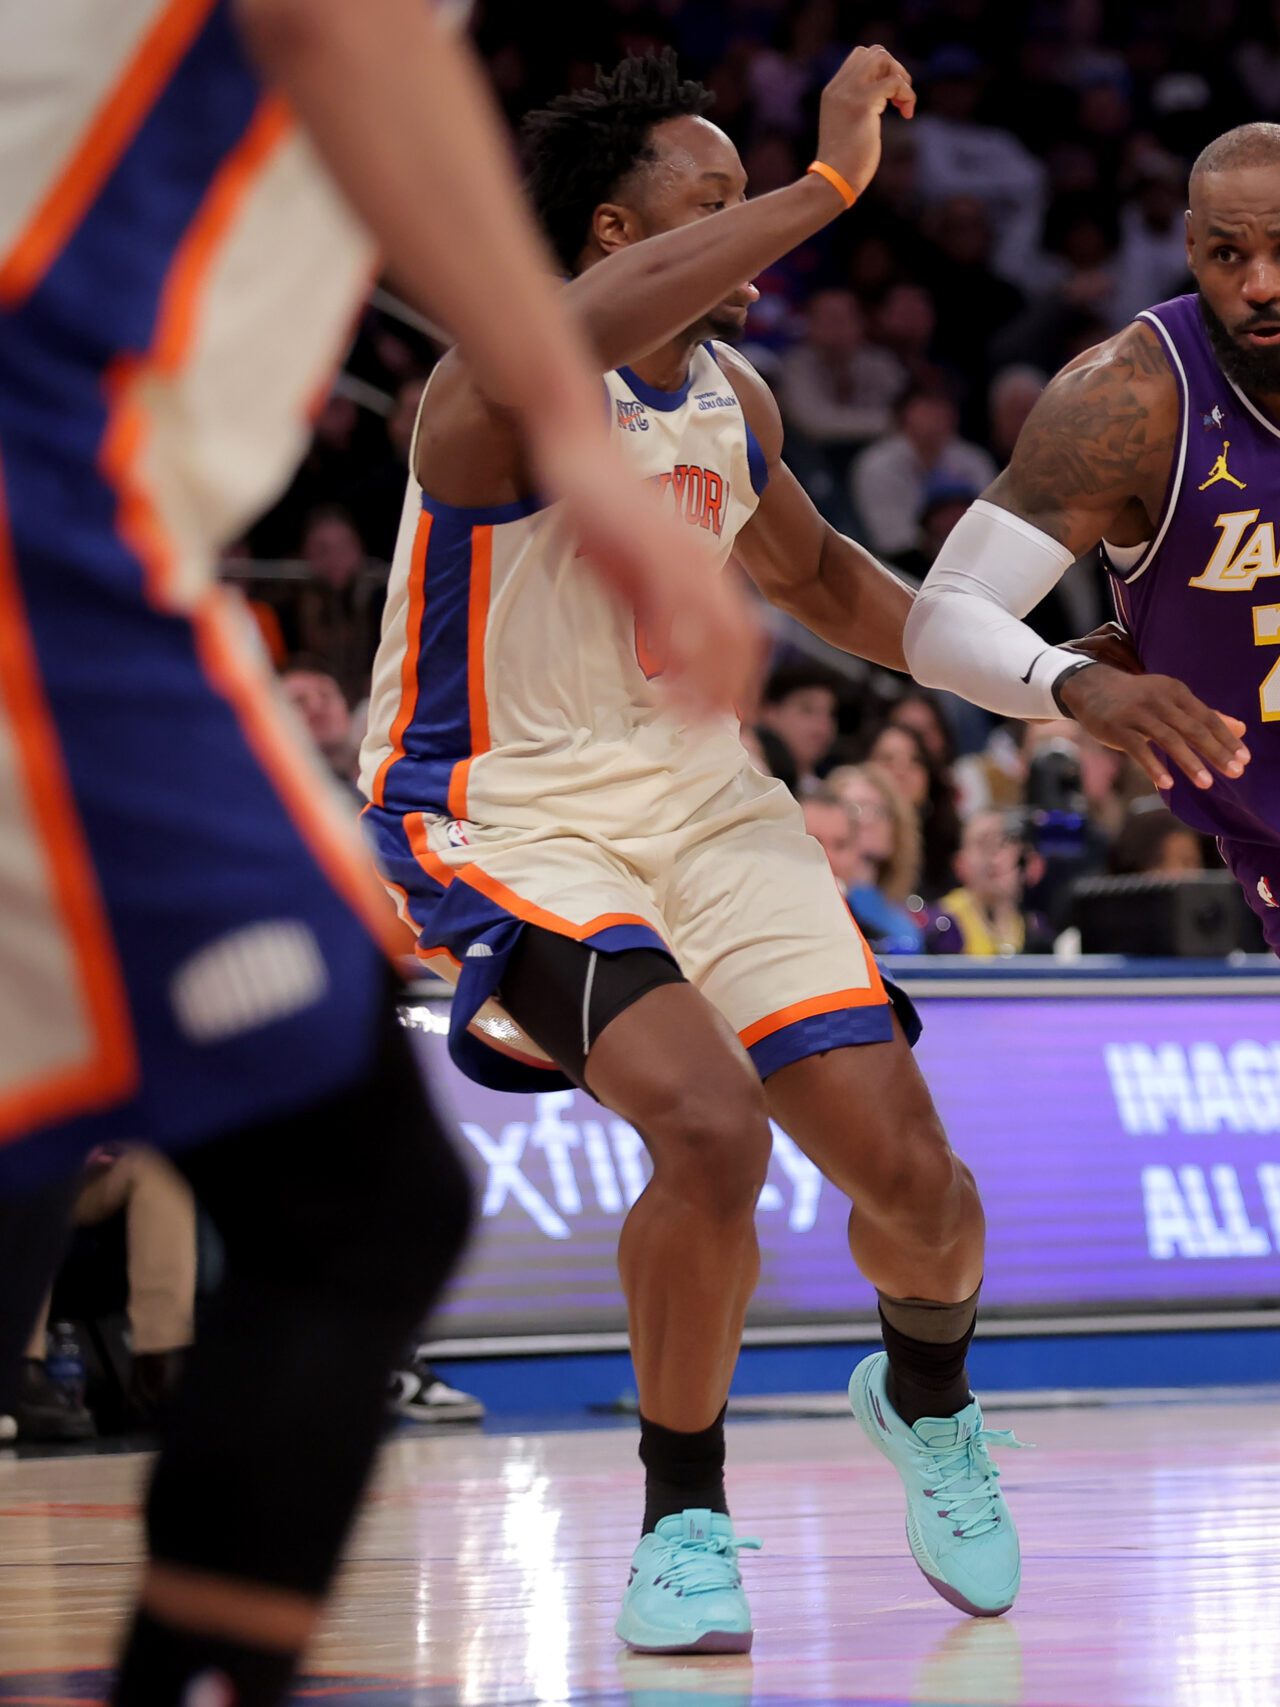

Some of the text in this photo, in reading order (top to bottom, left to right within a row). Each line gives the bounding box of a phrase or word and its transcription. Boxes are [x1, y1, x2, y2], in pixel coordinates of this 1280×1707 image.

[698, 394, 737, 411] abu dhabi
[673, 465, 730, 540] YOR
[460, 1090, 821, 1240] xfiy
[1140, 1163, 1272, 1260] ALL
